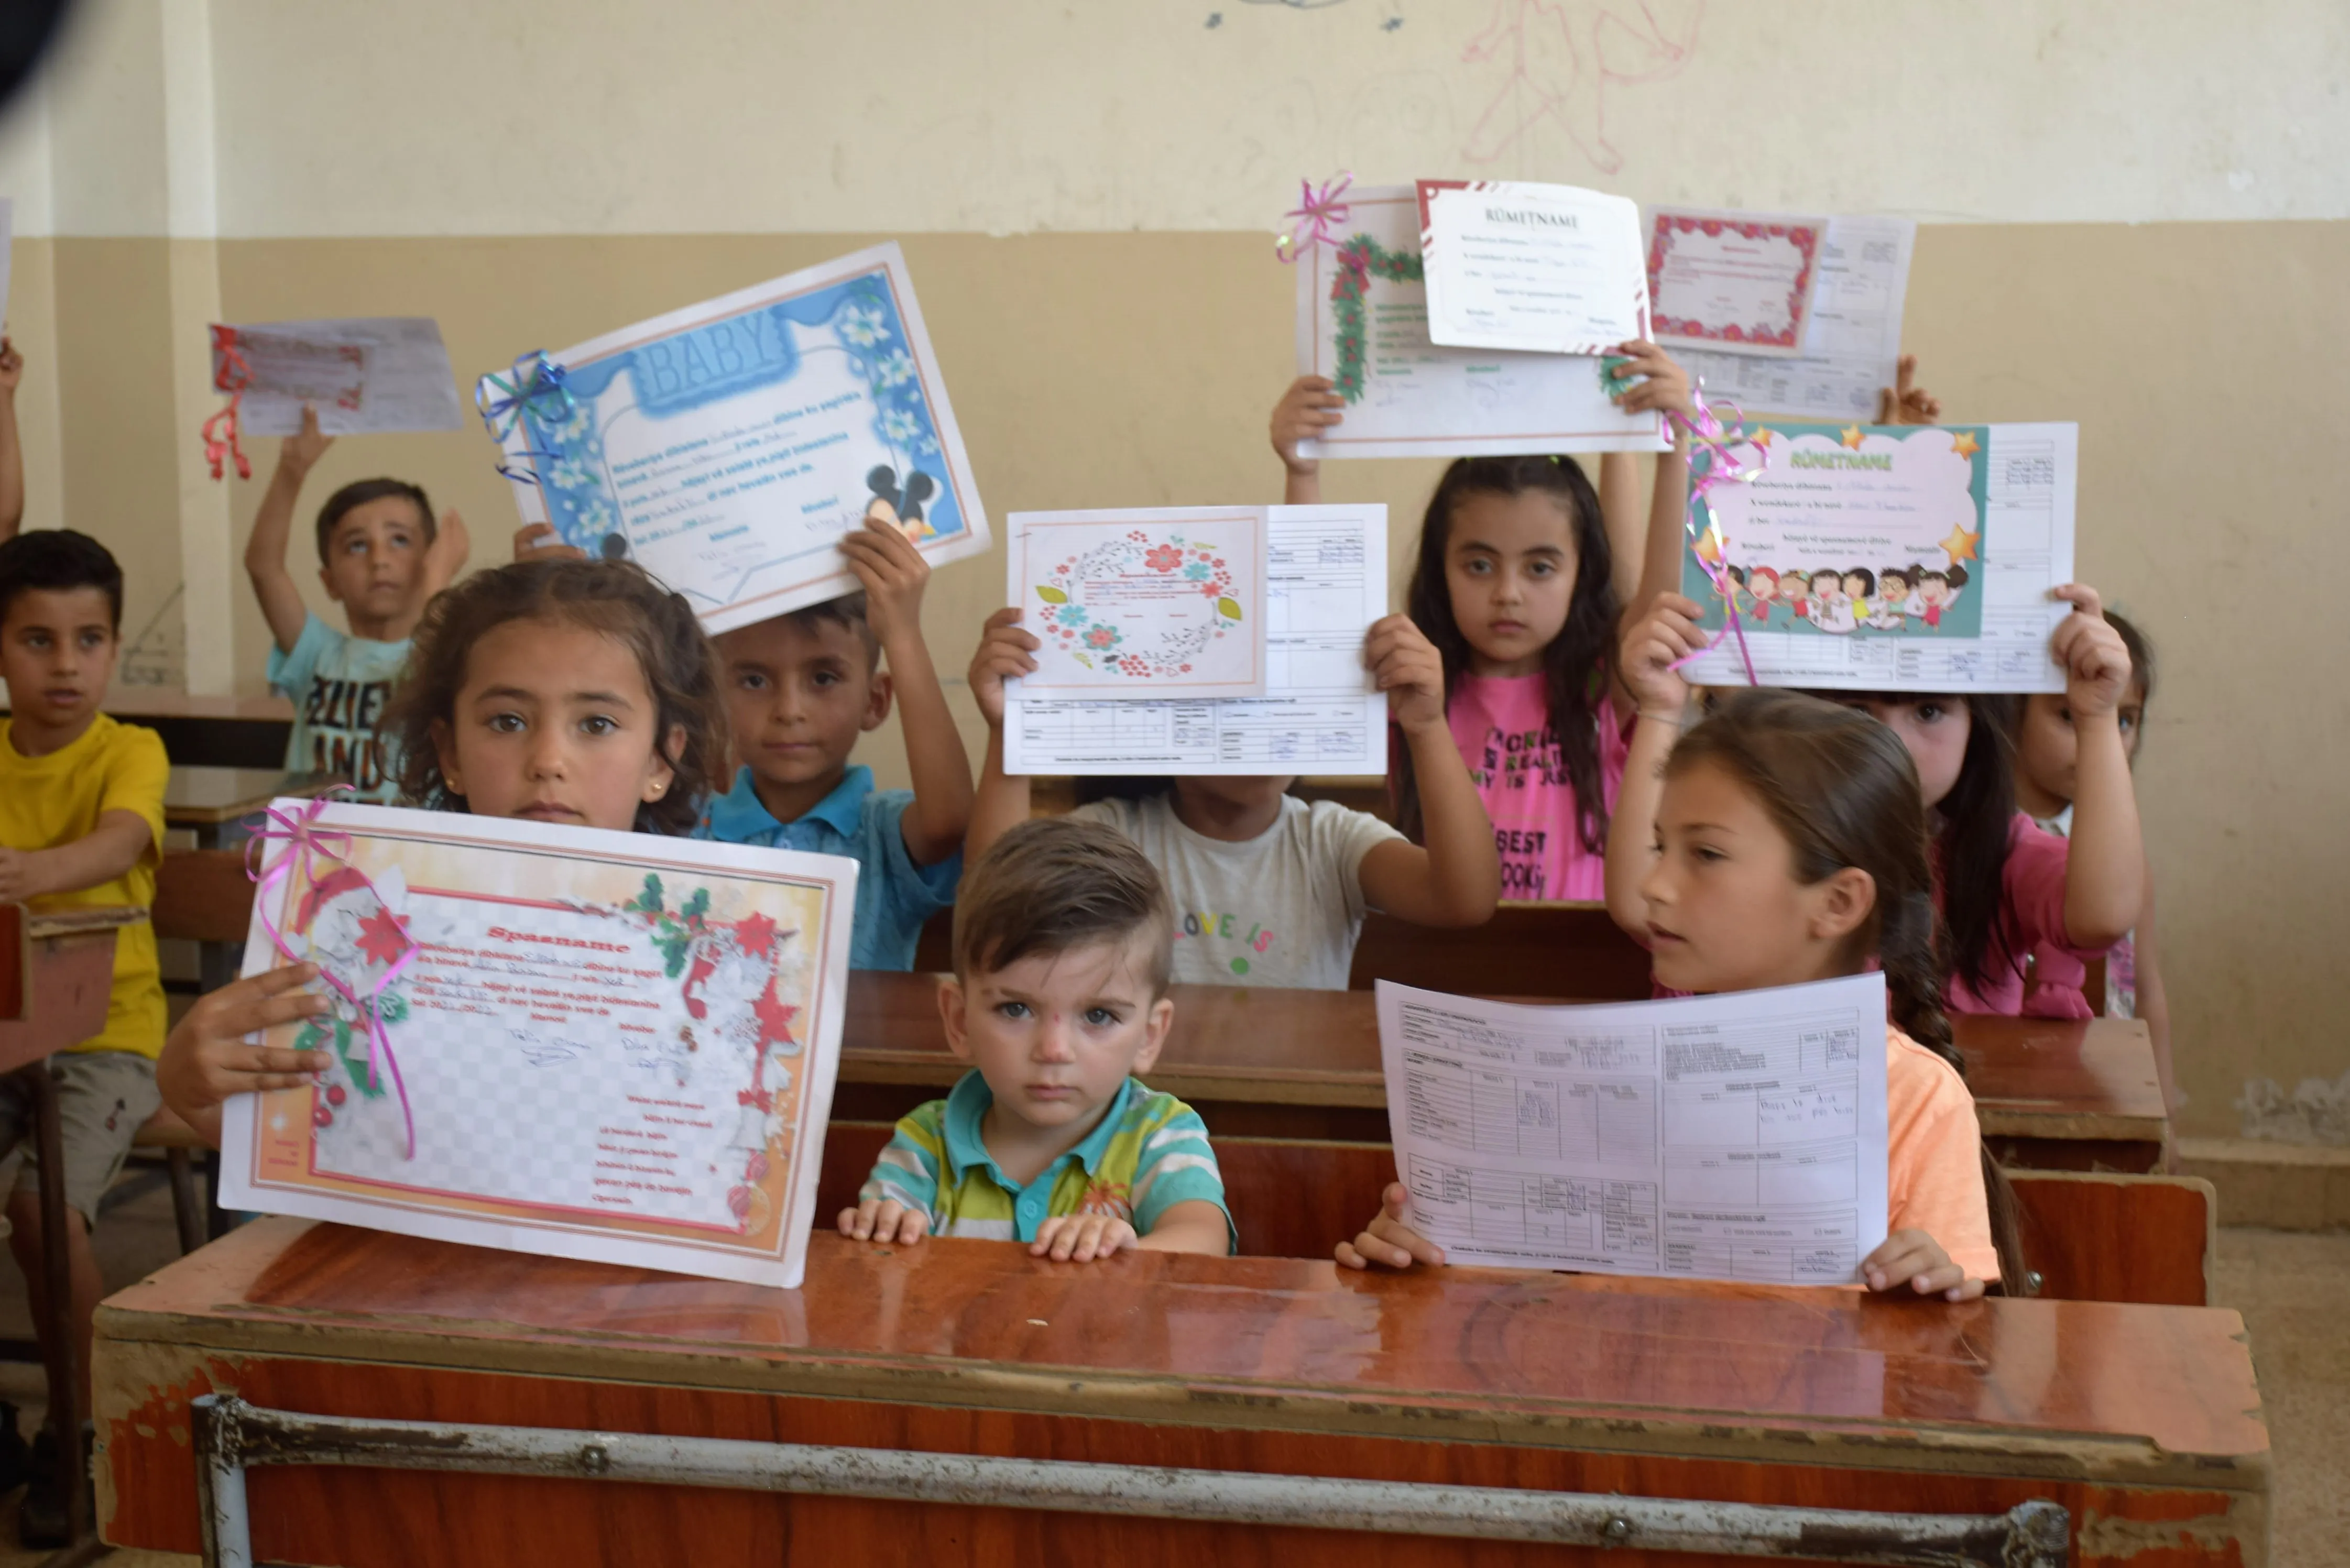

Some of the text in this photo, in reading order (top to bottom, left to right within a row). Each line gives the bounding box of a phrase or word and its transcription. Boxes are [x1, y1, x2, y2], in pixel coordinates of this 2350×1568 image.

[647, 311, 776, 397] BABY
[1495, 830, 1546, 854] BEST
[487, 926, 631, 953] Spasname
[1173, 912, 1274, 952] OVE IS
